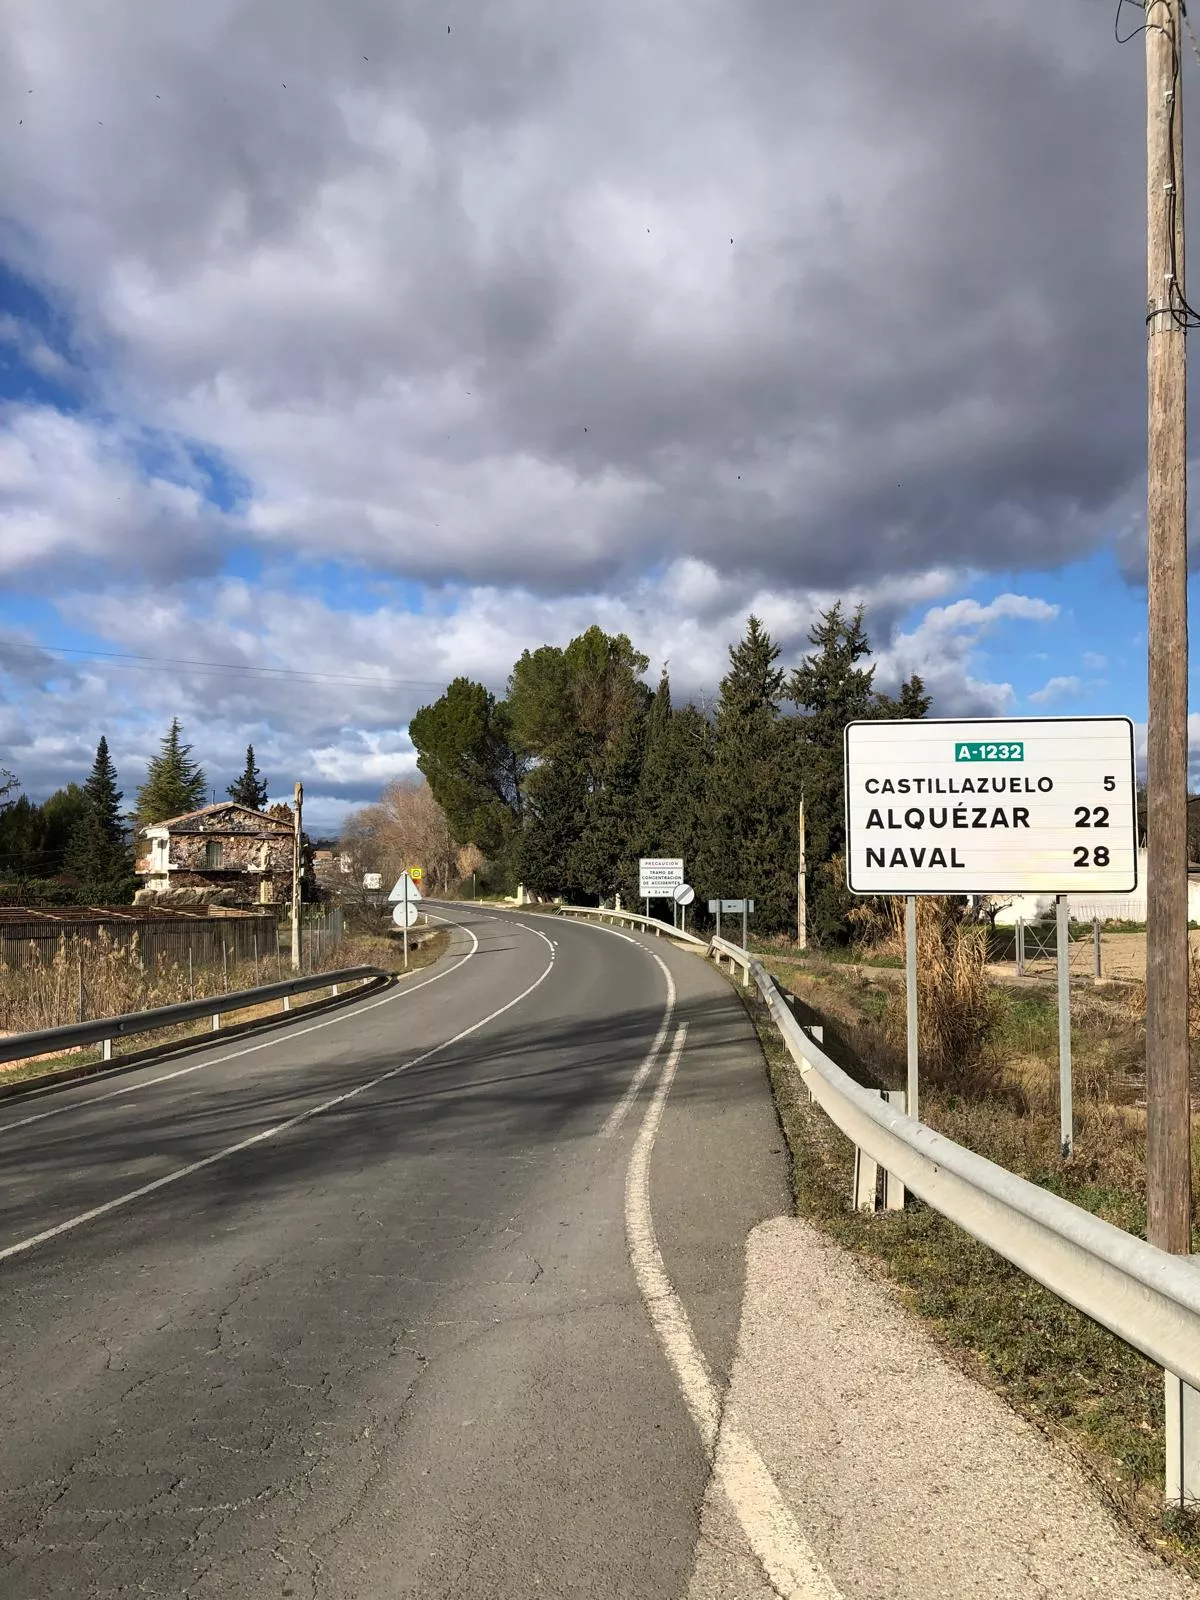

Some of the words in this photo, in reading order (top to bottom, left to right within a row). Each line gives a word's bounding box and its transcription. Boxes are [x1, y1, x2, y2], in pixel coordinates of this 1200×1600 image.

[958, 744, 1022, 760] A-1232
[865, 777, 1054, 795] CASTILLAZUELO
[1103, 776, 1116, 792] 5
[866, 802, 1031, 830] ALQUÉZAR
[1074, 806, 1110, 828] 22
[865, 848, 966, 868] NAVAL
[1073, 846, 1110, 868] 28
